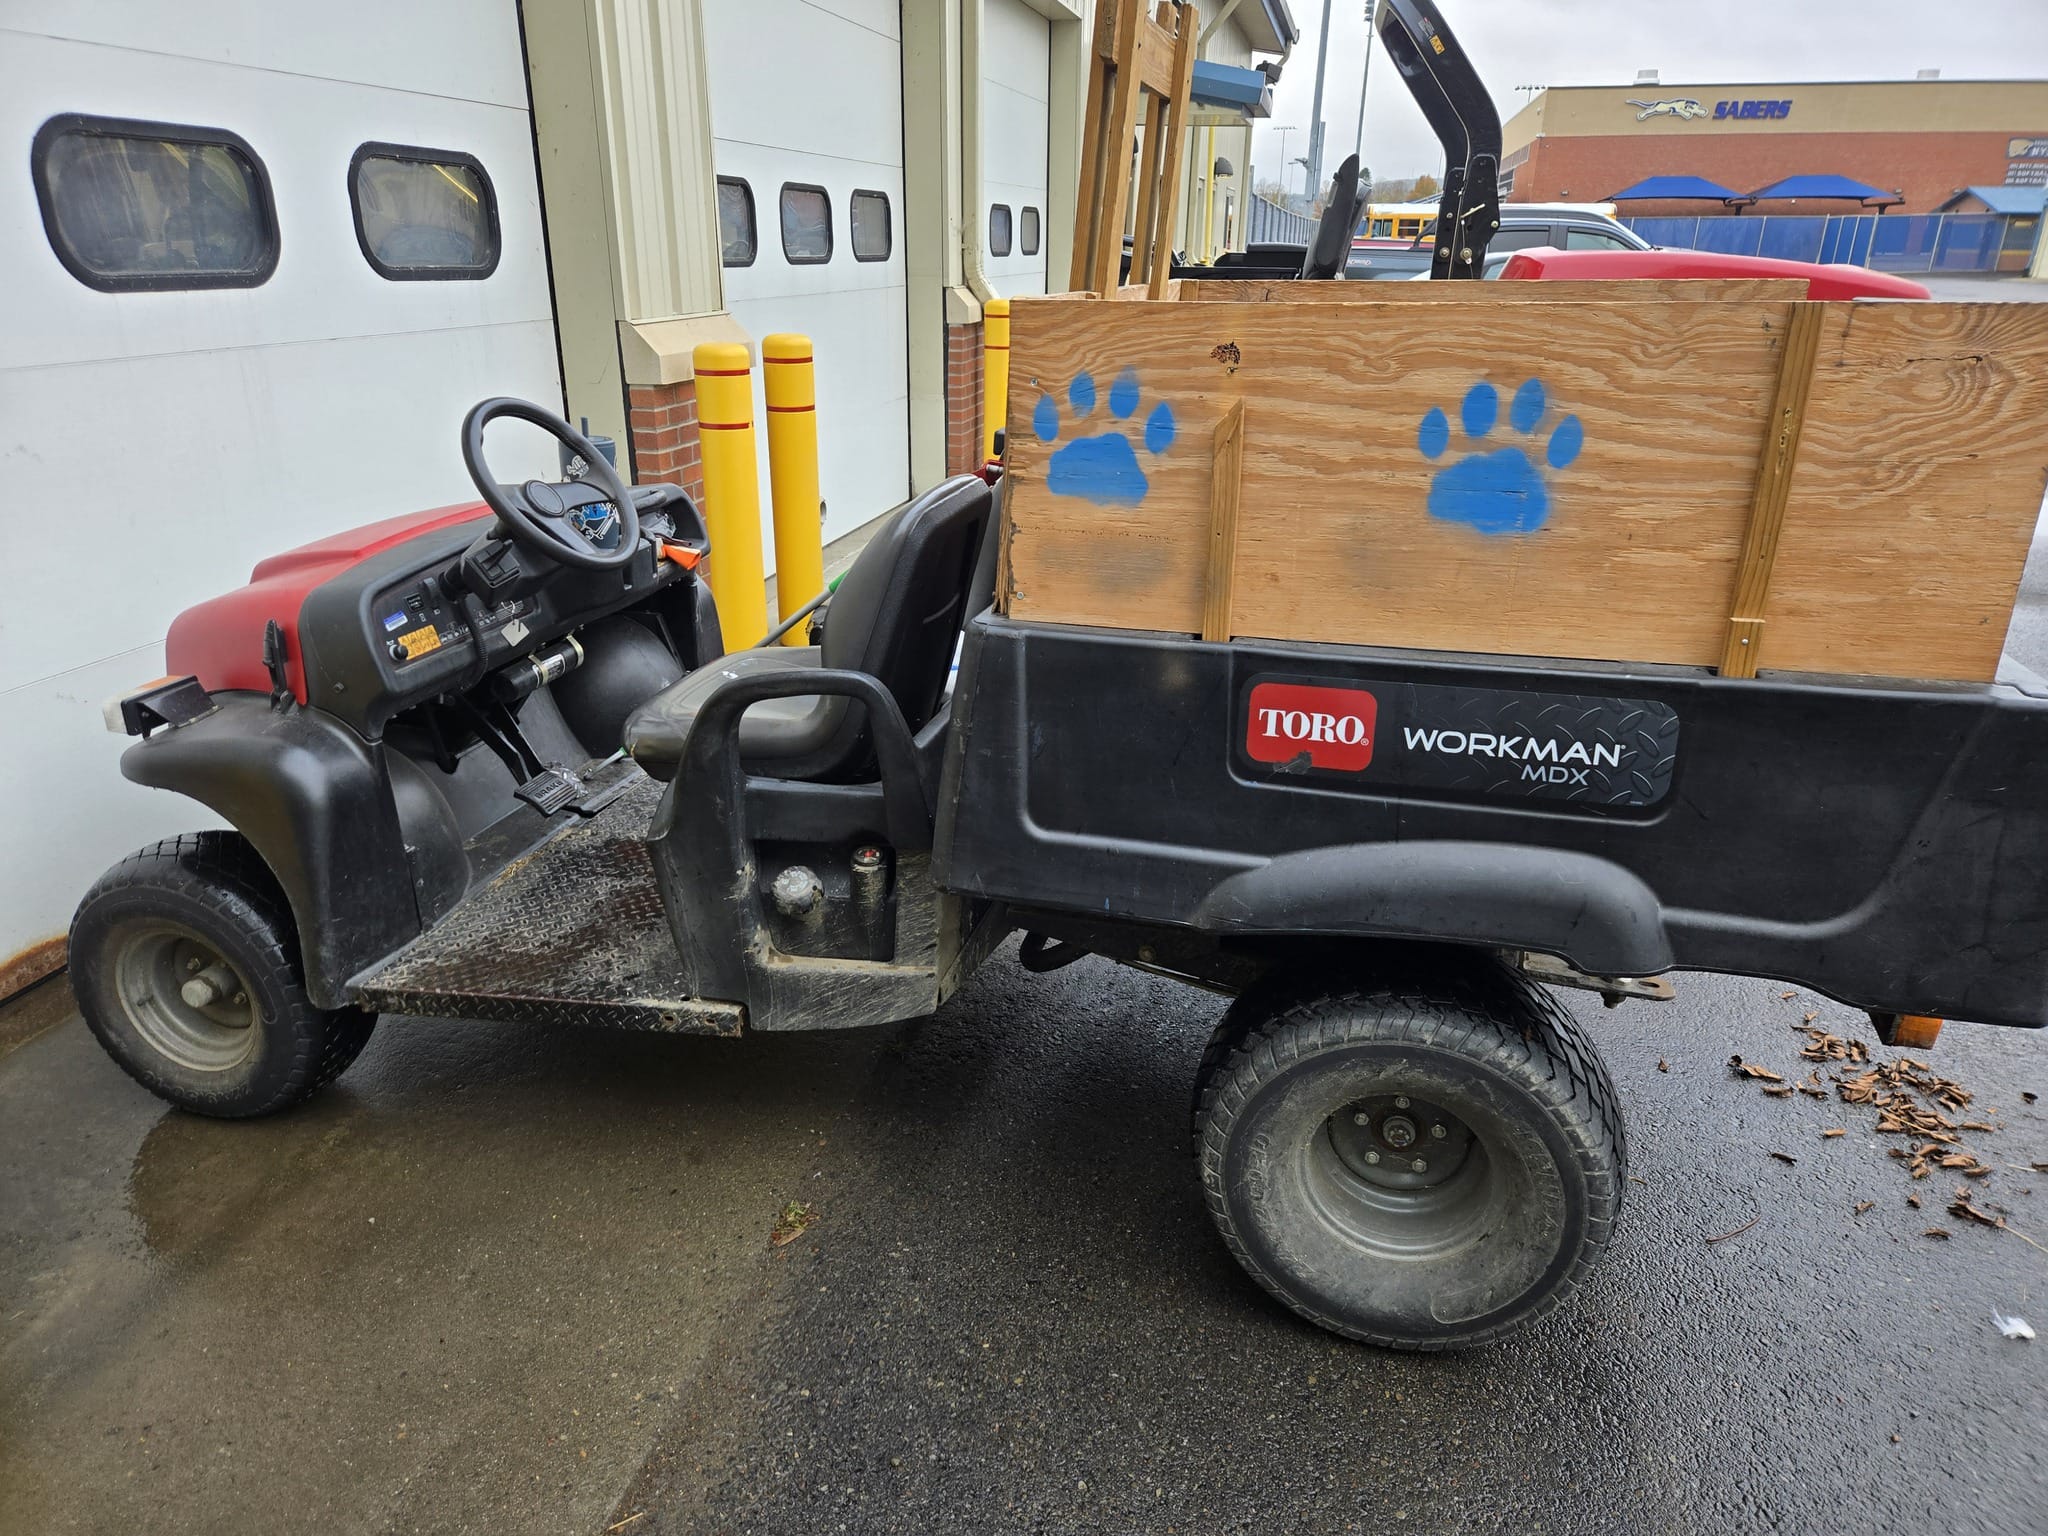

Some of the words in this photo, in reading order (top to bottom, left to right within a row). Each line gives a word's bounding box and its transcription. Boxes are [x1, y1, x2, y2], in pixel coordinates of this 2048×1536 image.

[1712, 100, 1793, 120] SABERS
[1258, 708, 1366, 745] TORO
[1403, 727, 1622, 768] WORKMAN
[1520, 764, 1591, 786] MDX
